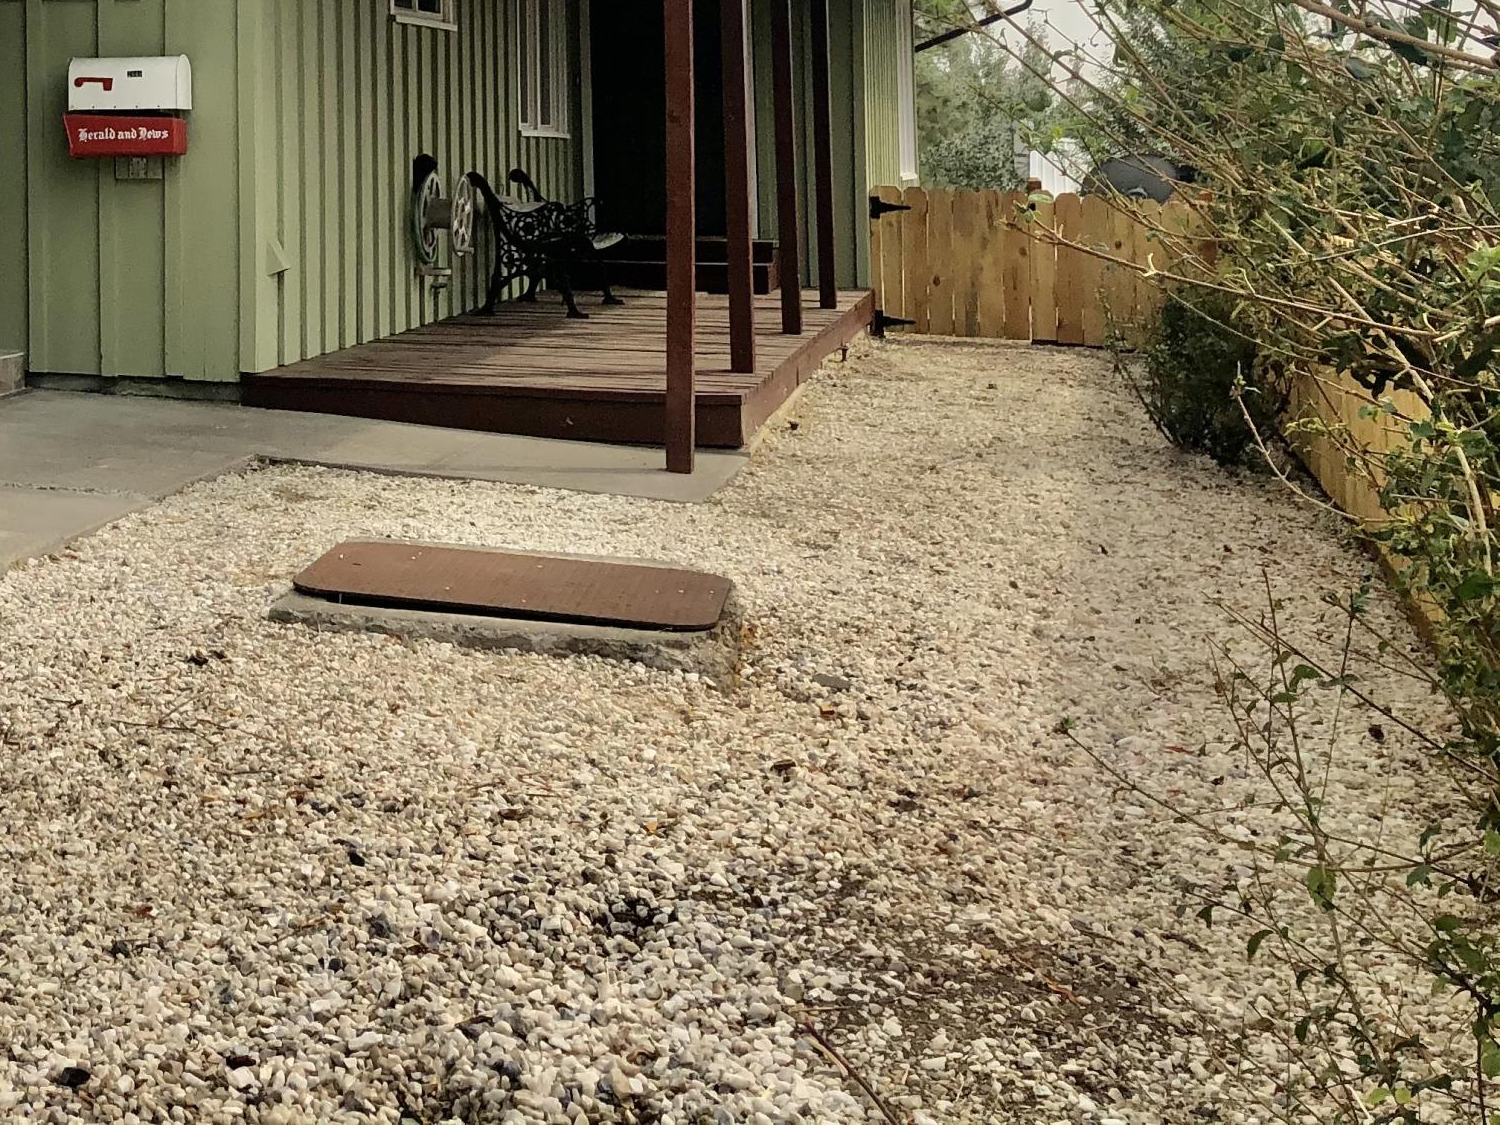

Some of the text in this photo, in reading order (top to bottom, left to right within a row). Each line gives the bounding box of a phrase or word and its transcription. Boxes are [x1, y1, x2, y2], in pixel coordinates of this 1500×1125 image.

[78, 127, 169, 142] Herald and News
